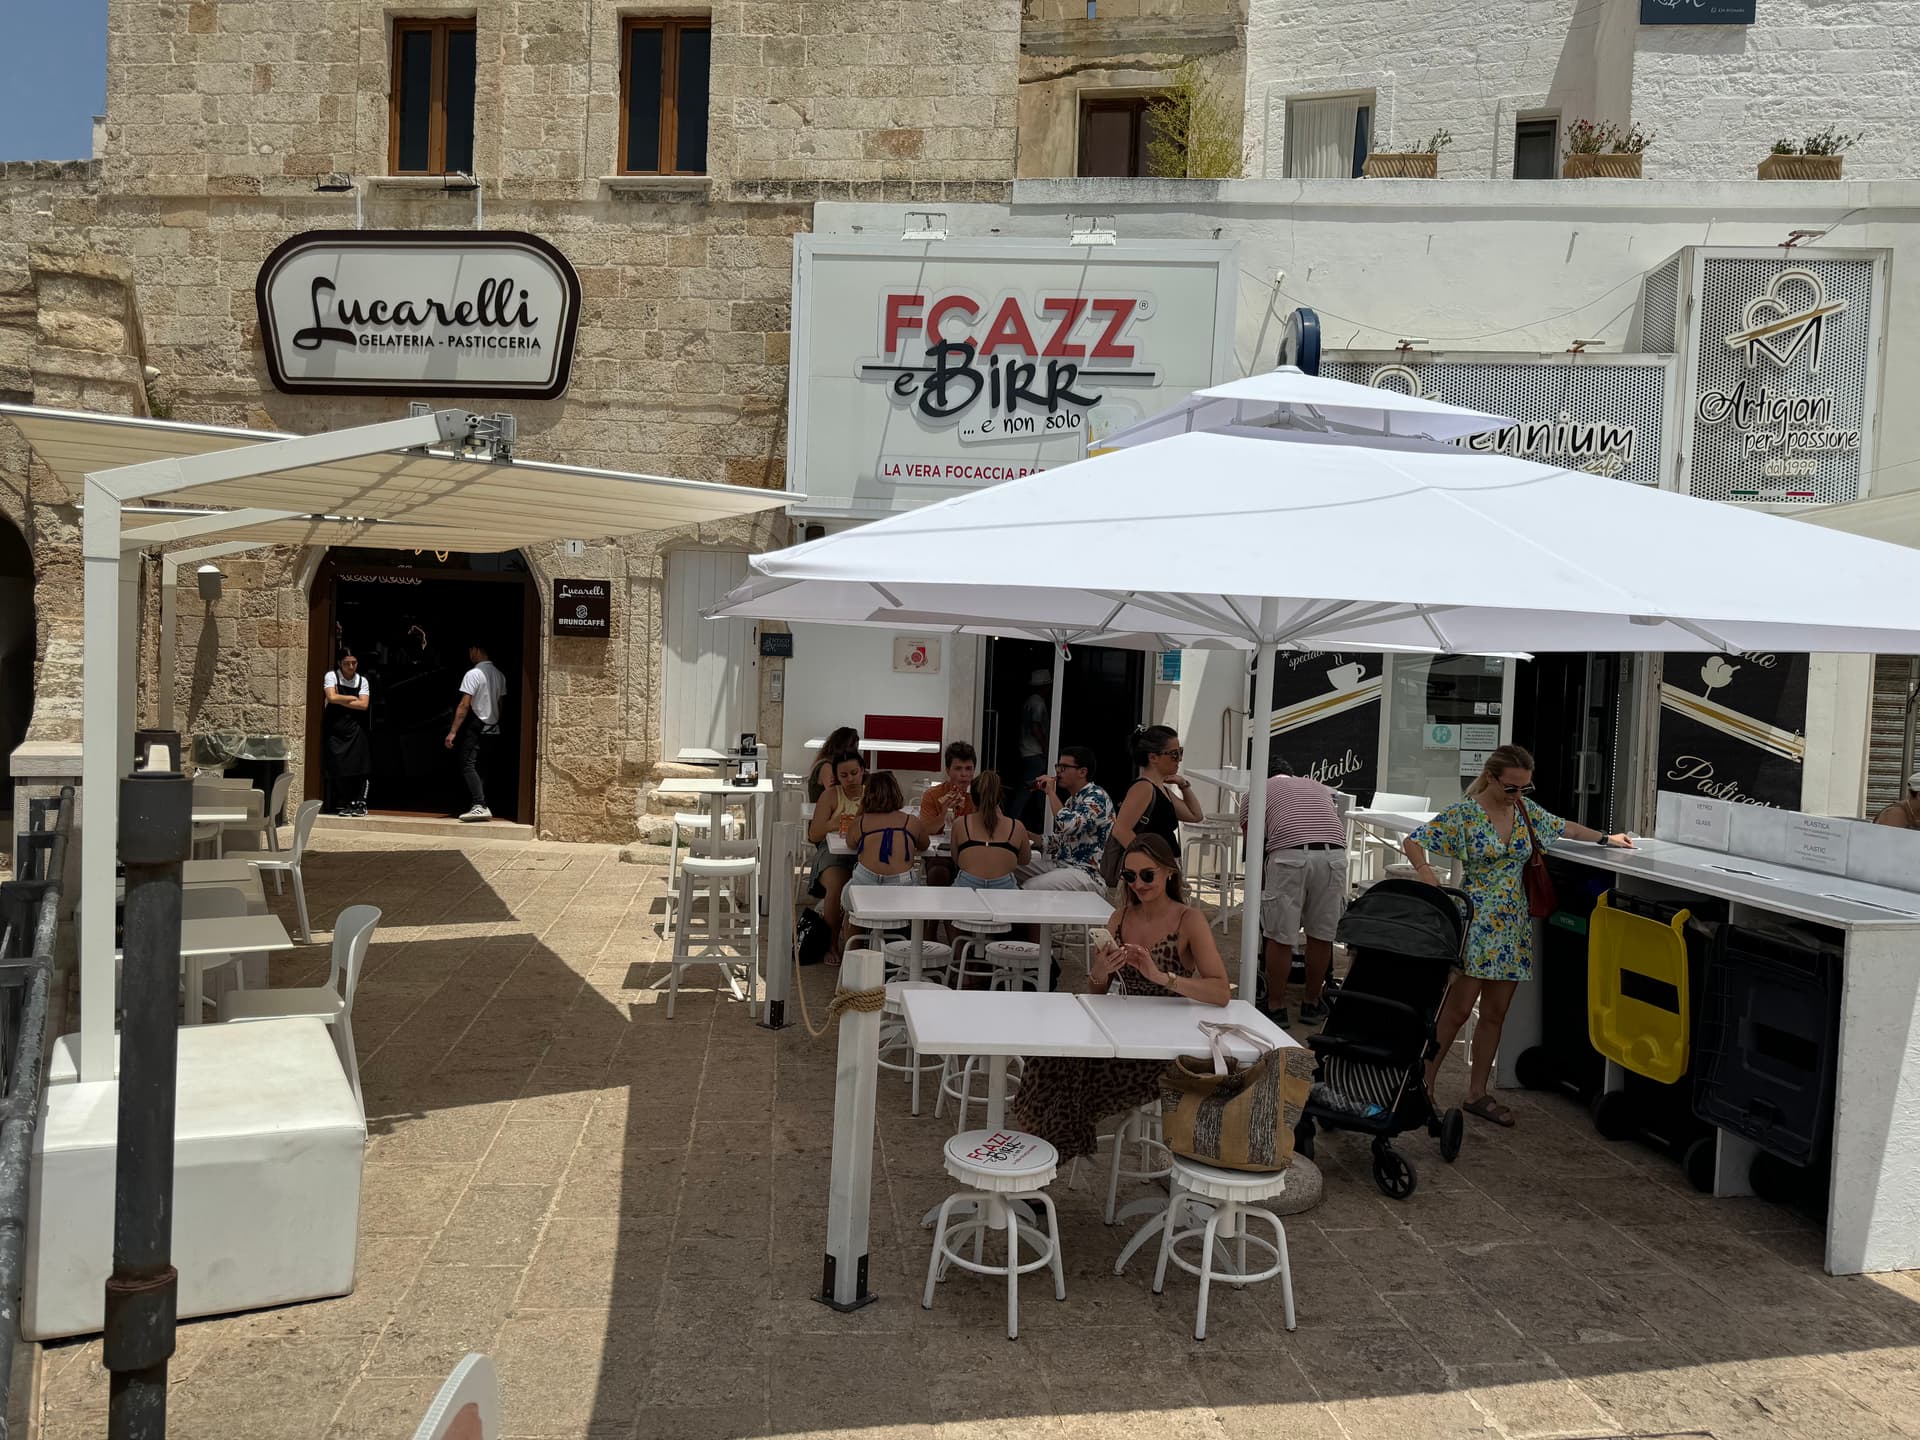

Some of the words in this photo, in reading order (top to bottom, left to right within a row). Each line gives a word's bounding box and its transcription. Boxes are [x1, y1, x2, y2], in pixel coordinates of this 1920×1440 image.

[293, 276, 539, 351] Lucarelli
[359, 334, 435, 348] GELATERIA
[448, 335, 542, 350] PASTICCERIA
[893, 371, 920, 397] e
[981, 416, 996, 434] e
[1003, 413, 1035, 434] non
[1046, 409, 1081, 431] solo
[1699, 379, 1832, 445] Artigiani
[1456, 413, 1633, 460] ennium
[1744, 430, 1774, 458] per
[1785, 426, 1858, 457] passione
[884, 464, 902, 477] LA
[906, 464, 941, 478] VERA
[945, 465, 1015, 480] FOCACCIA
[1766, 460, 1783, 476] dal
[1785, 461, 1816, 477] 1999
[571, 542, 577, 553] 1
[559, 584, 605, 599] Lucarelli
